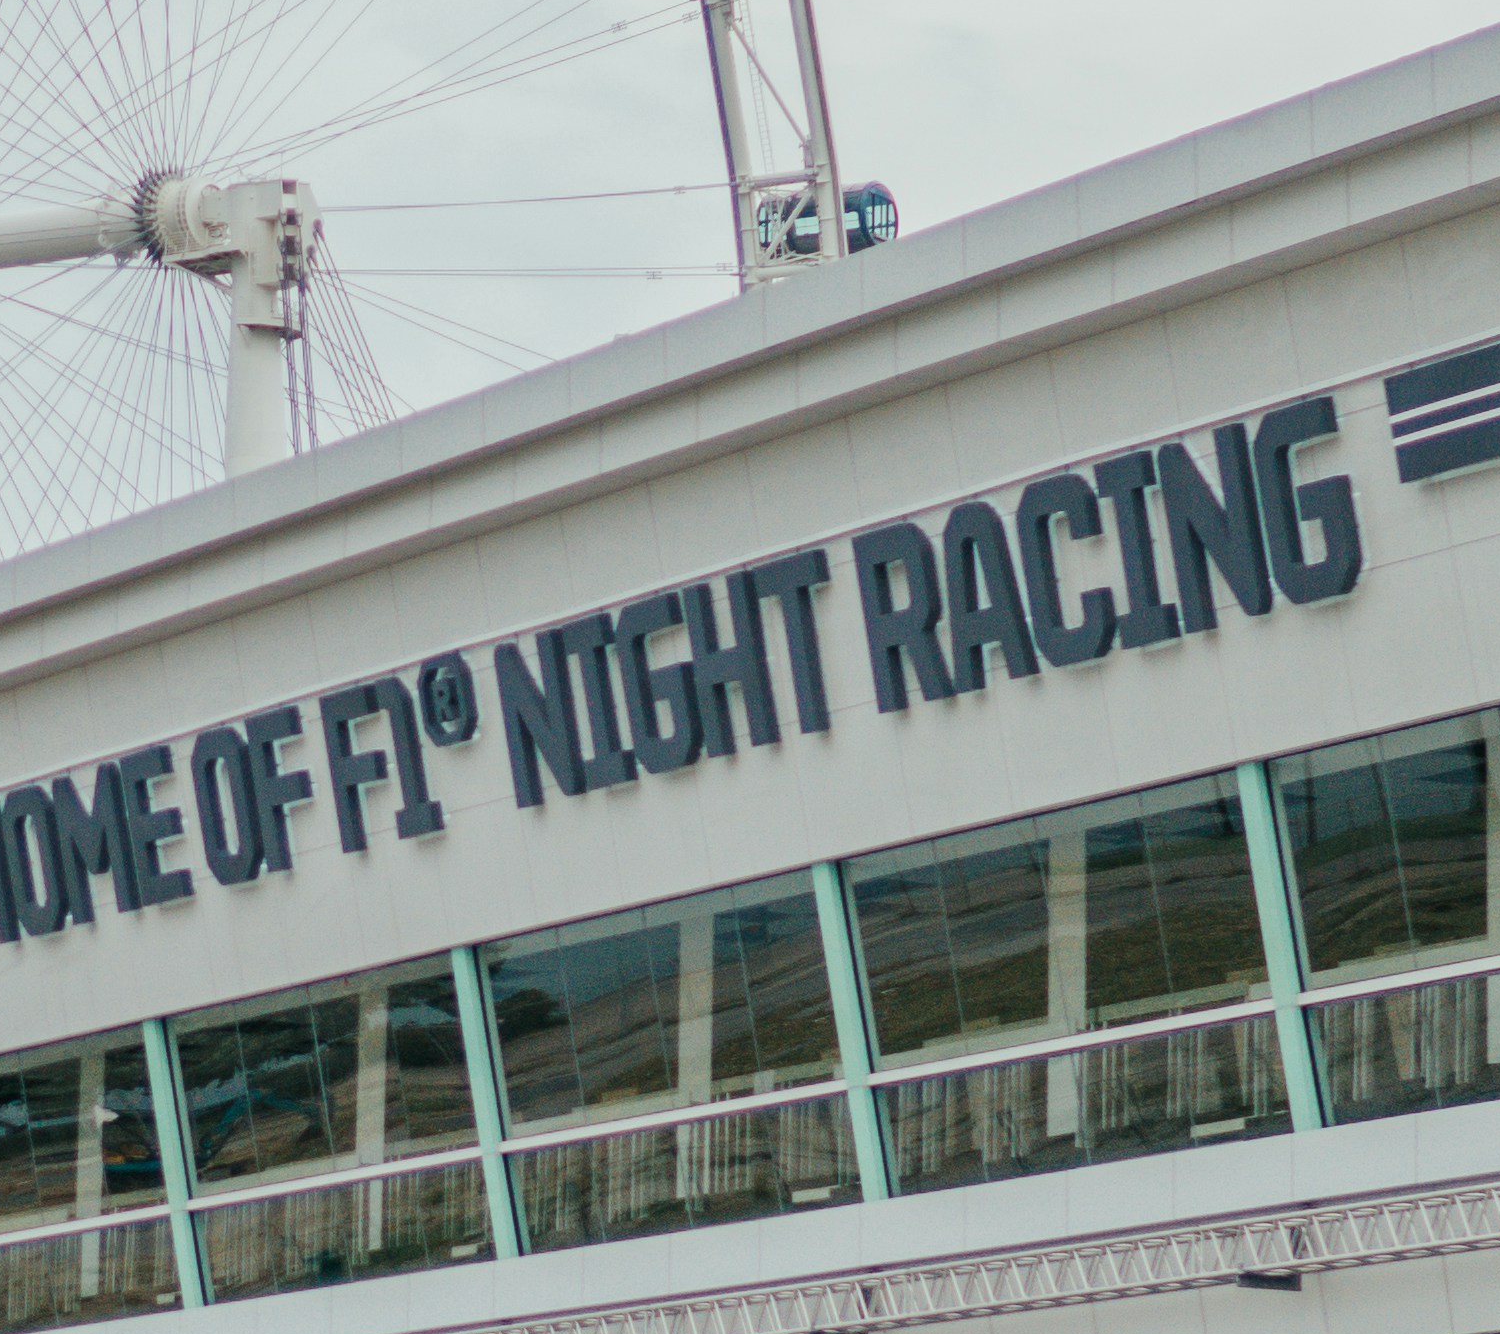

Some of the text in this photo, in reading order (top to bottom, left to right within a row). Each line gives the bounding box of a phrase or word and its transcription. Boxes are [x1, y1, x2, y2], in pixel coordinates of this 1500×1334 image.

[190, 705, 313, 886] OF
[319, 648, 479, 854] F1®
[493, 548, 831, 809] NIGHT
[851, 395, 1364, 714] RACING
